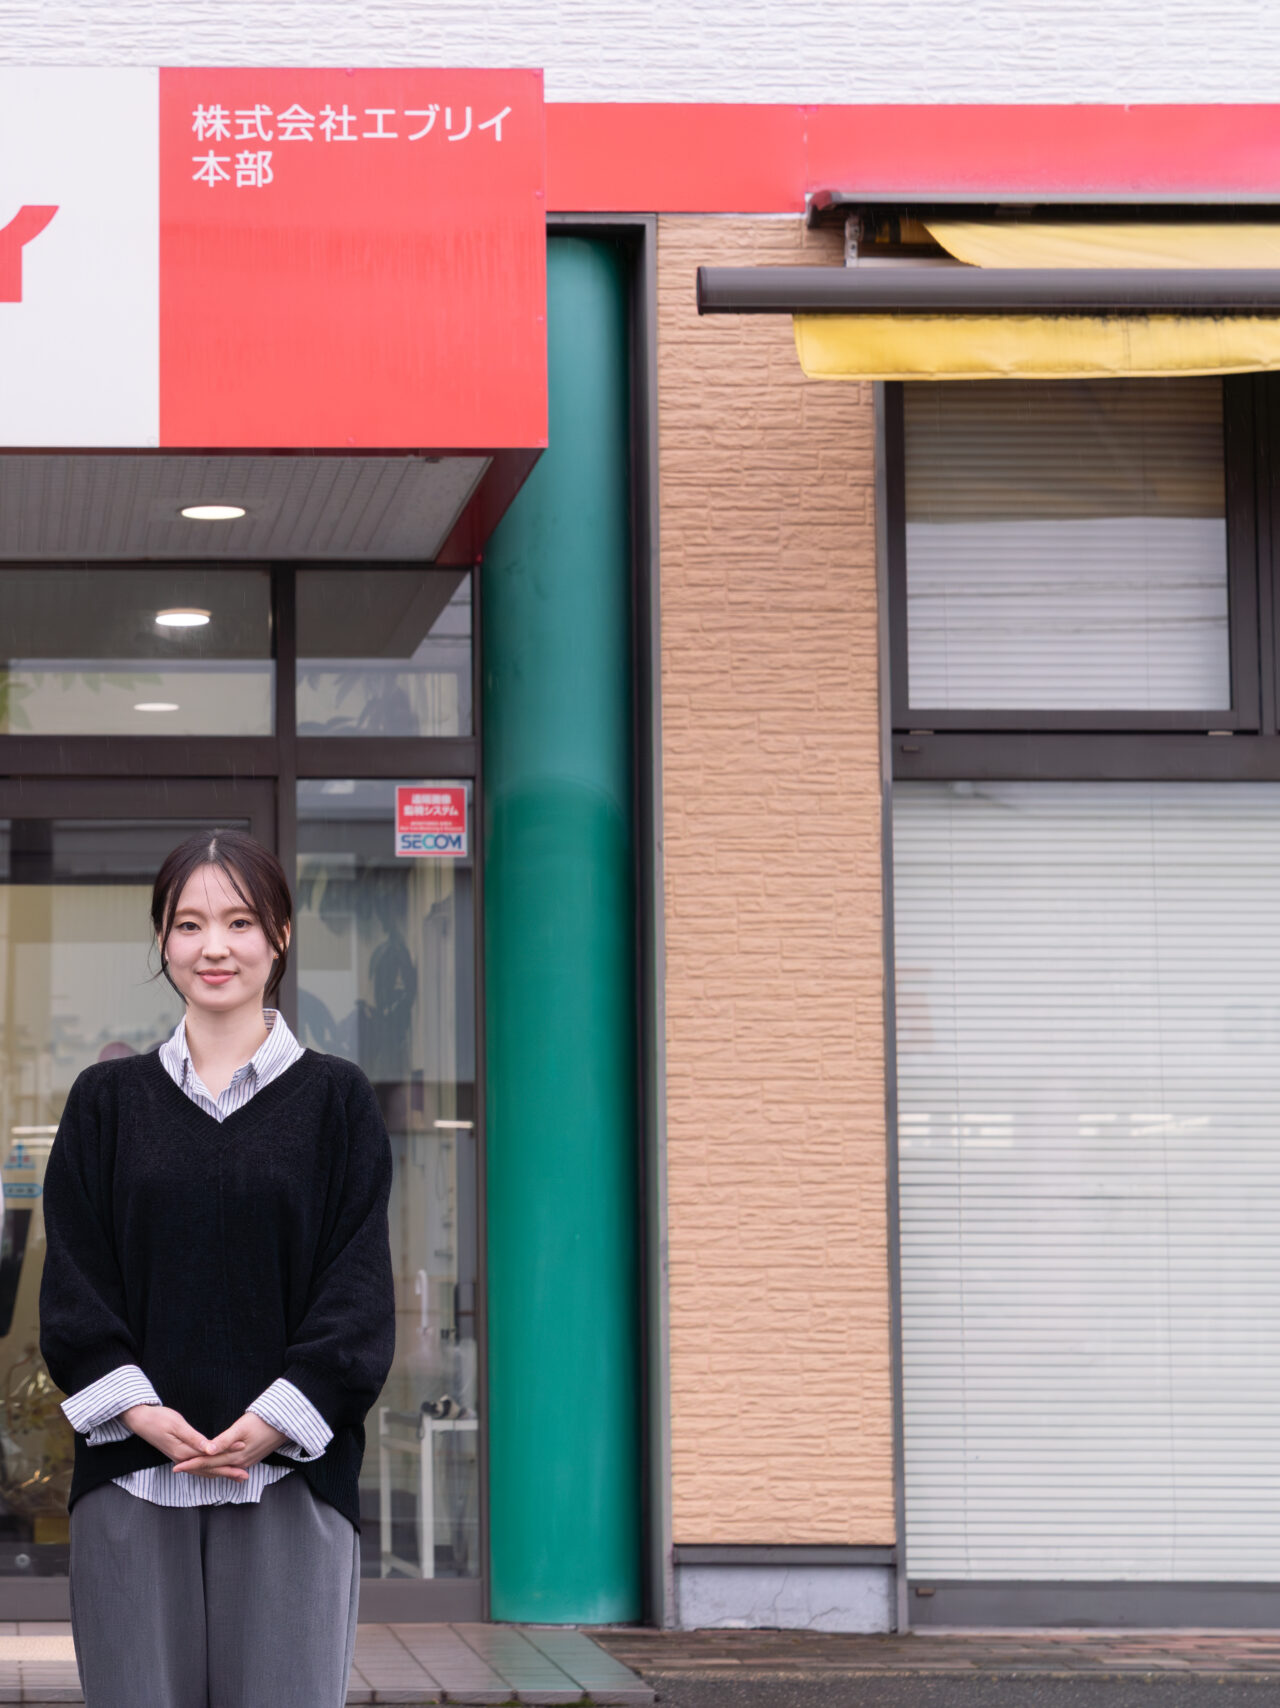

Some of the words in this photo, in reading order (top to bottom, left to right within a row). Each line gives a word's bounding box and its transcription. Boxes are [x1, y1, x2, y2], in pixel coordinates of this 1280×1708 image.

[192, 104, 512, 142] 株式会社エブリイ
[192, 150, 274, 188] 本部
[401, 834, 462, 849] SECOM
